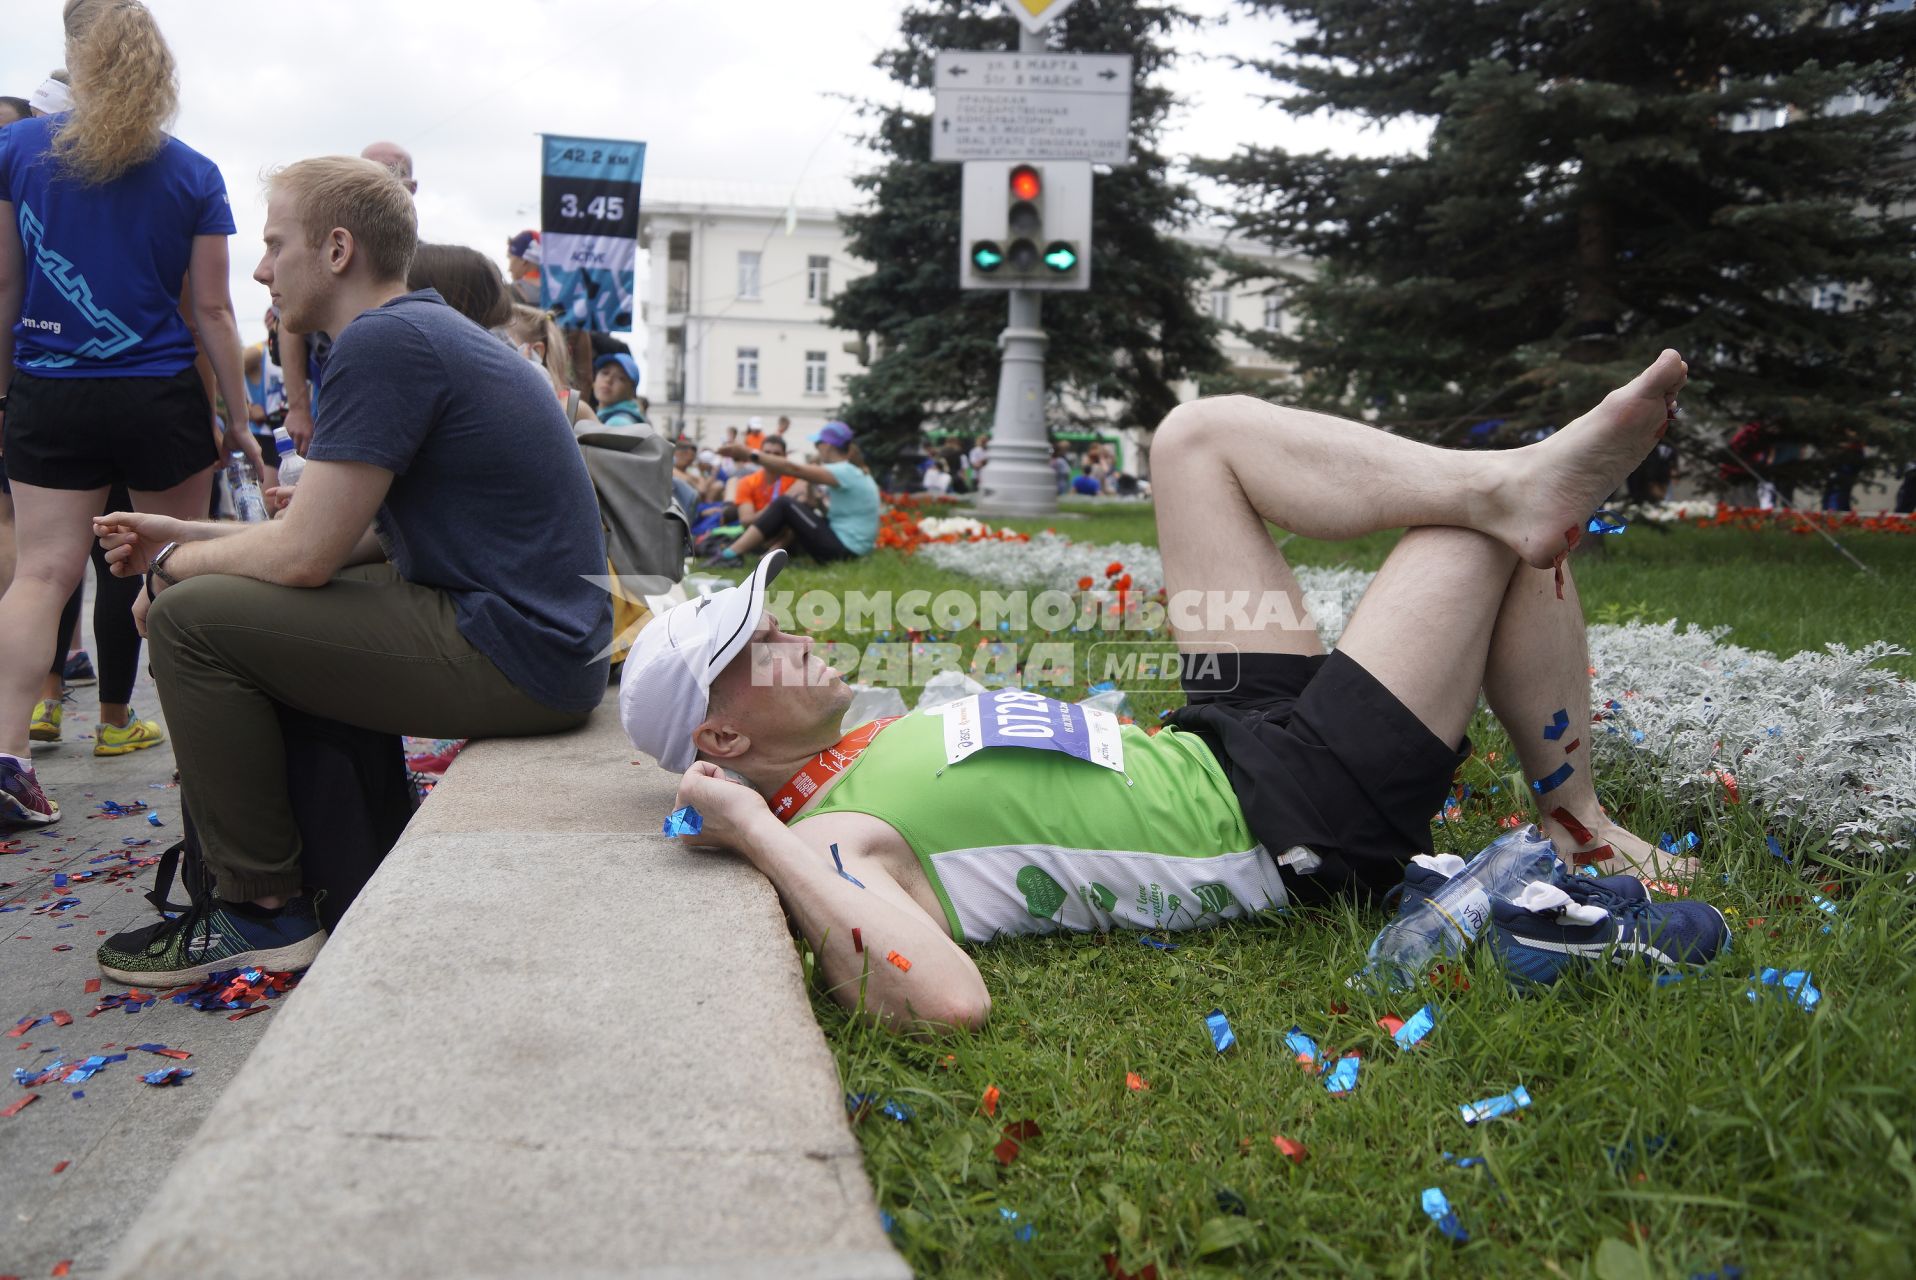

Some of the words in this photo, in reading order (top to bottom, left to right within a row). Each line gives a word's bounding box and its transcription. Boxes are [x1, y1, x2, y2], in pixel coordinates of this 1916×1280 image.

[561, 193, 625, 220] 3.45
[993, 691, 1055, 738] 0728
[1136, 884, 1147, 905] love
[1149, 882, 1161, 918] cycling
